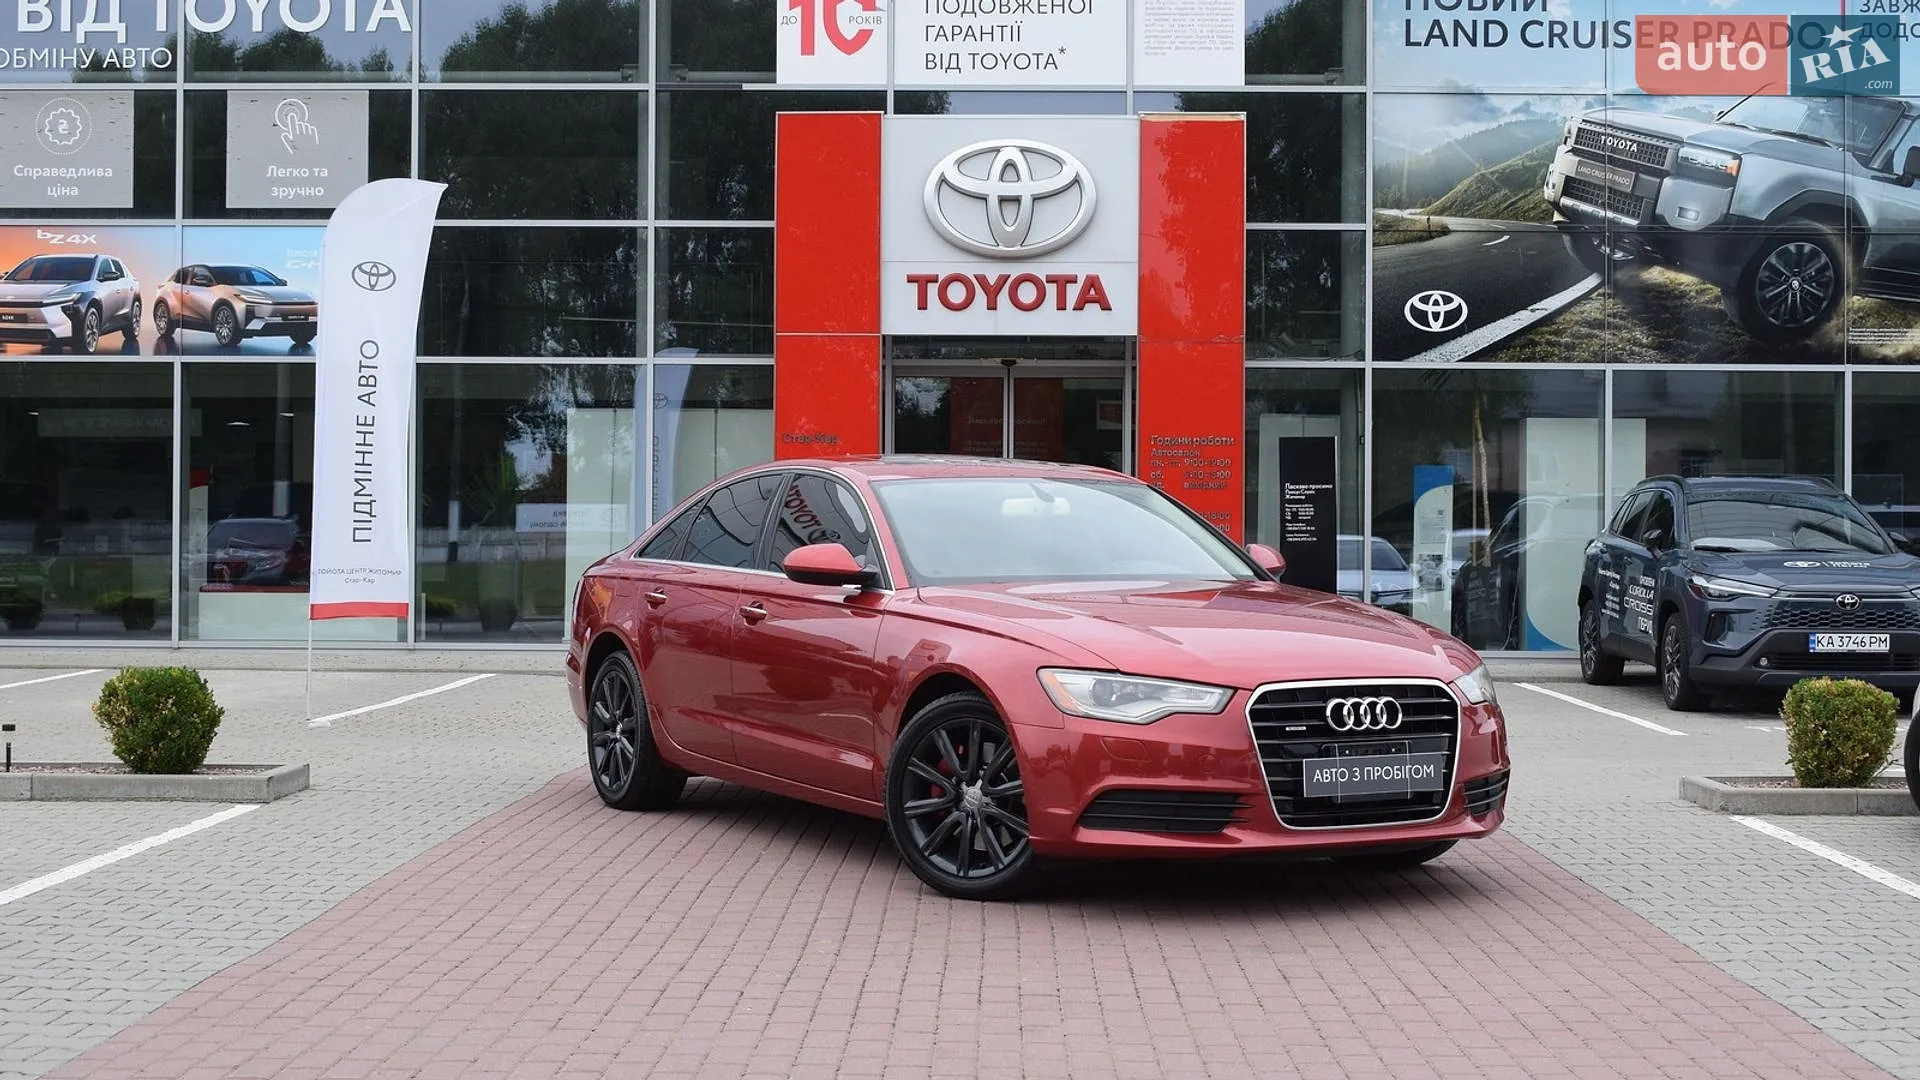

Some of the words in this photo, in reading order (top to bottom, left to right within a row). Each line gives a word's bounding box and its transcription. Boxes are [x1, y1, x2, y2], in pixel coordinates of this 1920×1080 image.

[17, 0, 127, 44] ВІД
[781, 15, 798, 25] ДО
[848, 15, 883, 25] РОКІВ
[925, 20, 1023, 42] ГАРАНТІЇ
[1405, 18, 1508, 47] LAND
[1519, 20, 1679, 49] CRUISER
[1694, 20, 1827, 50] PRADO
[103, 48, 173, 68] АВТО
[925, 53, 961, 73] ВІД
[1600, 135, 1638, 152] TOYOTA
[13, 164, 113, 179] Справедлива
[266, 165, 310, 177] Легко
[312, 167, 328, 177] та
[47, 183, 79, 197] ціна
[271, 186, 325, 199] зручно
[906, 272, 1113, 312] TOYOTA
[357, 339, 380, 407] АВТО
[1150, 434, 1192, 447] Години
[1193, 434, 1235, 448] роботи
[352, 414, 377, 543] ПІДМІННЕ
[1629, 585, 1655, 600] COROLLA
[1623, 597, 1655, 616] CROSS
[1816, 635, 1835, 648] KA
[1838, 635, 1866, 648] 3746
[1869, 635, 1888, 648] PM
[1313, 768, 1349, 783] АВТО
[1364, 764, 1435, 782] ПРОБІГОМ
